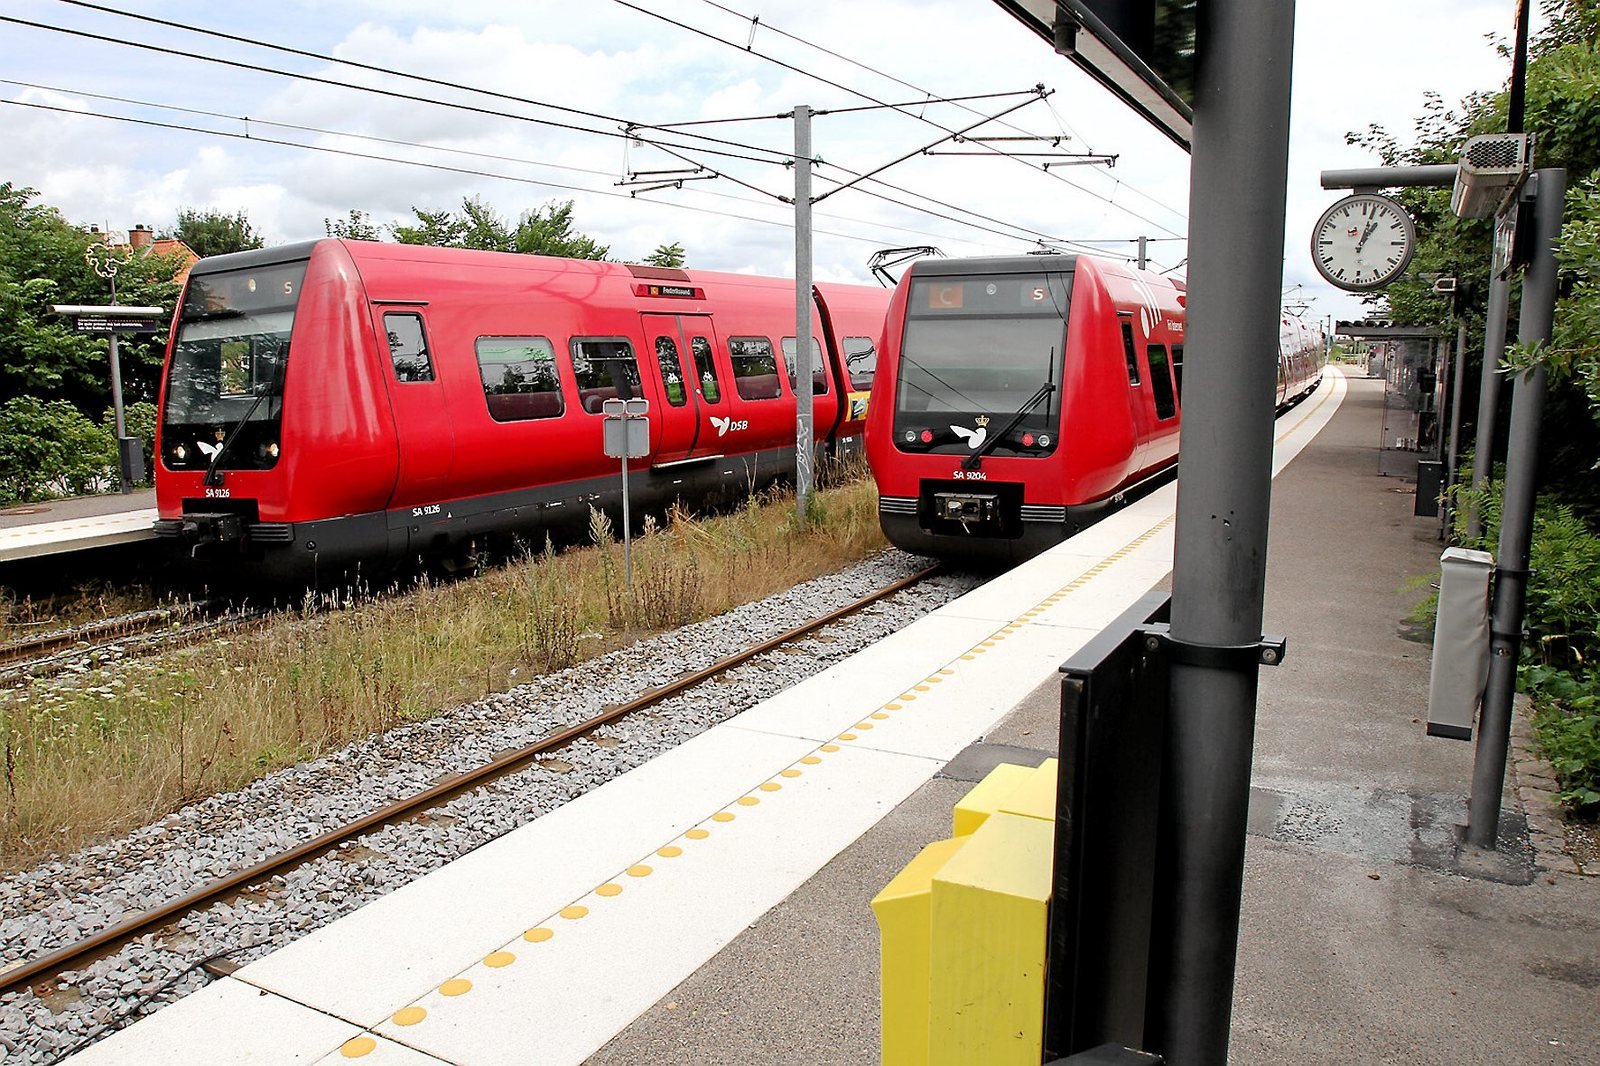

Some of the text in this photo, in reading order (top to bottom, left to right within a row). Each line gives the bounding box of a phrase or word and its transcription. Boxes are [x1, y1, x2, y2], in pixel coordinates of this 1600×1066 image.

[283, 281, 293, 294] S
[940, 287, 953, 305] C
[1033, 288, 1044, 300] S
[730, 420, 749, 431] DSB
[953, 470, 987, 480] SA 9204
[205, 488, 230, 498] SA 9126
[412, 504, 441, 517] SA 9126
